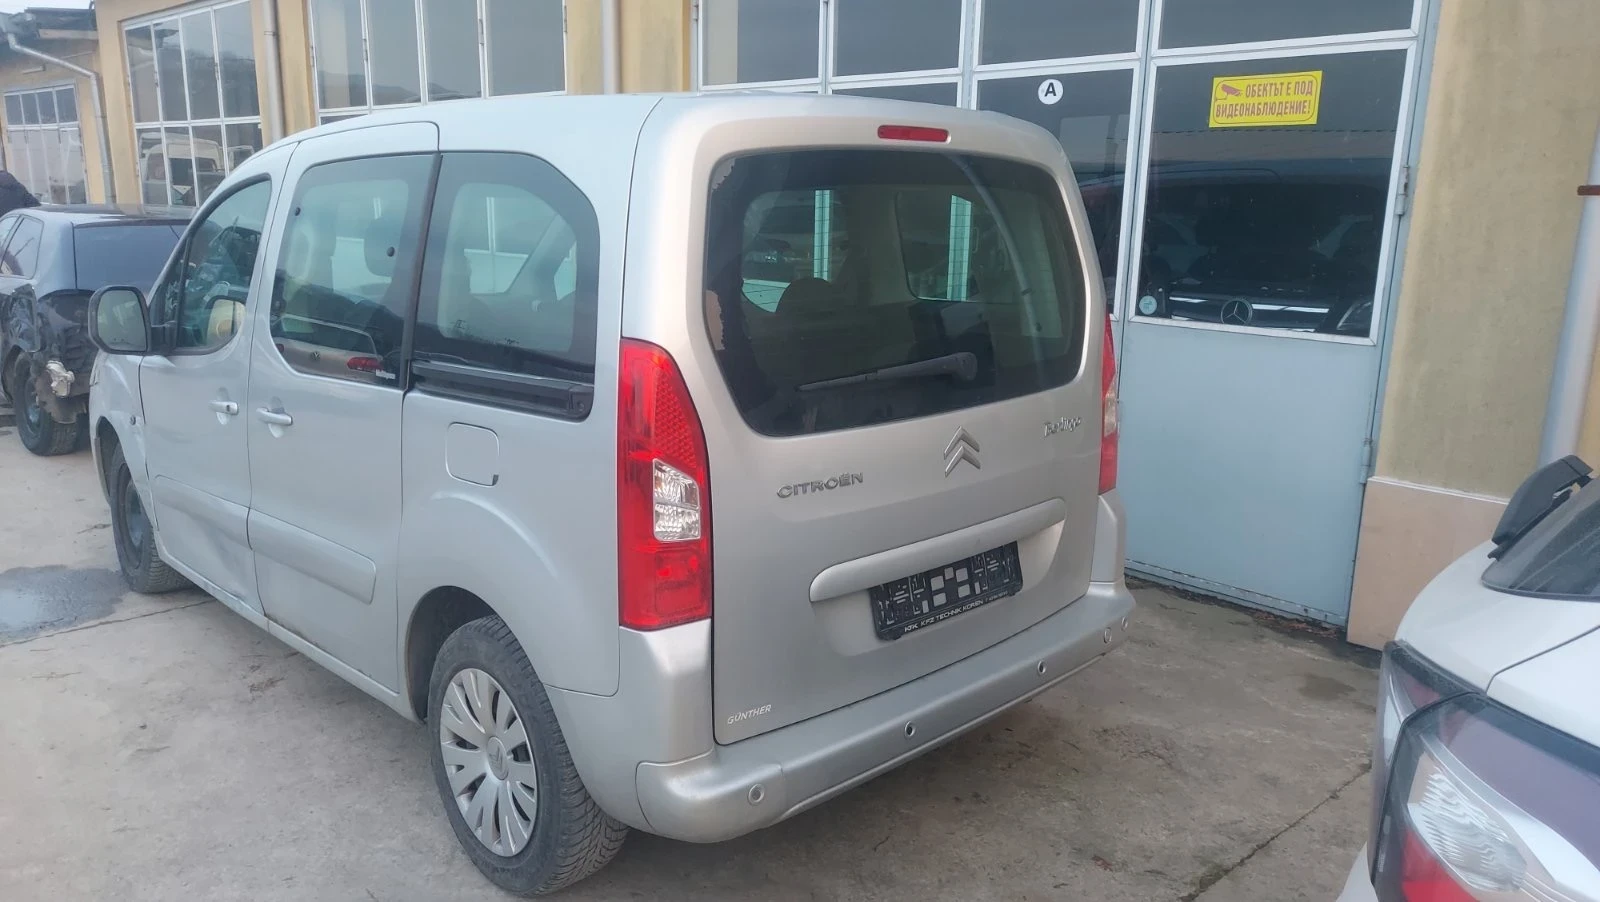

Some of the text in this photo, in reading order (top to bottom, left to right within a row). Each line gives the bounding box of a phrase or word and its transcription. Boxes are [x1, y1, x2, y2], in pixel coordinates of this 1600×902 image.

[1044, 82, 1057, 97] A
[1245, 80, 1313, 98] ОБЕКТЪТ Е ПОД
[1215, 100, 1311, 119] ВИДЕОНАБЛЮДЕНИЕ!
[776, 472, 864, 499] CITROËN
[920, 617, 935, 626] KFZ
[936, 607, 962, 621] TECHNIK
[962, 599, 984, 612] KOREN
[727, 704, 772, 725] GÜNTHER
